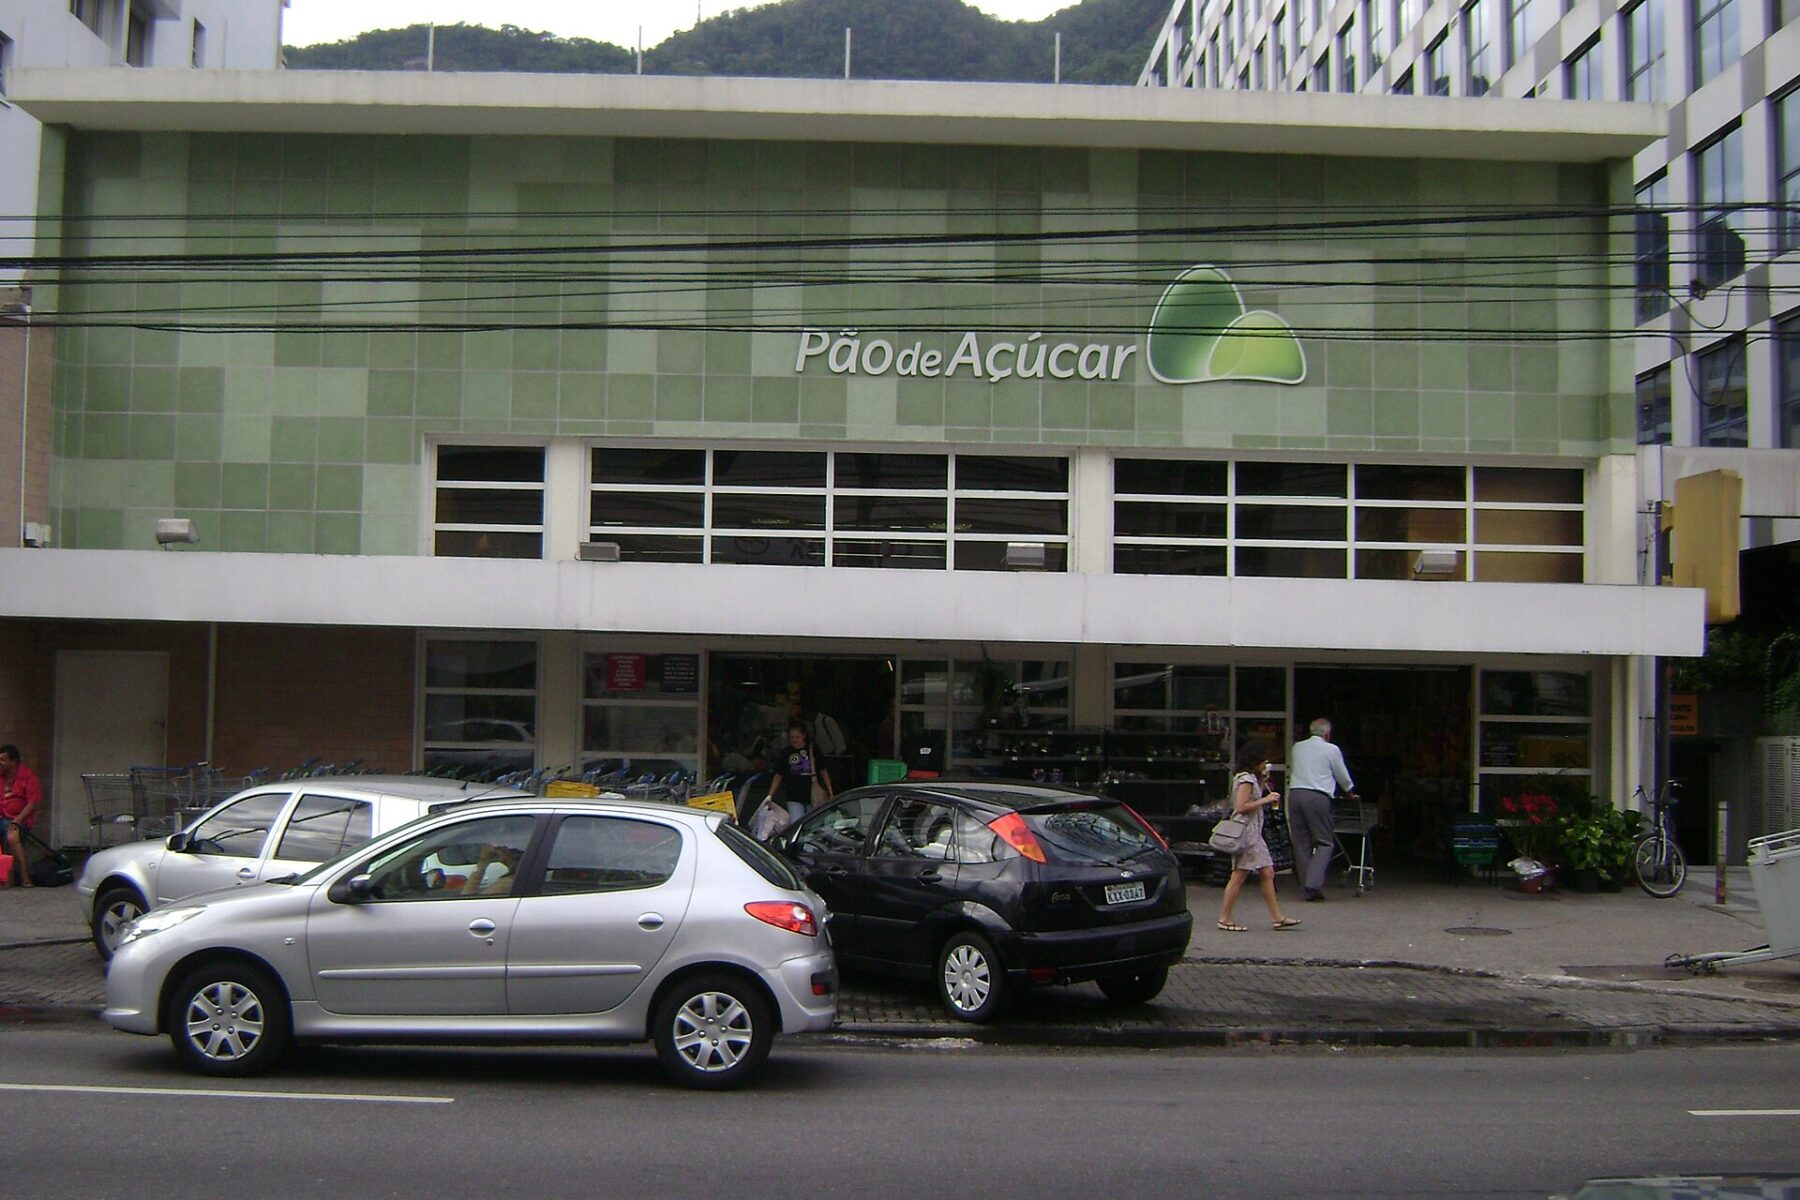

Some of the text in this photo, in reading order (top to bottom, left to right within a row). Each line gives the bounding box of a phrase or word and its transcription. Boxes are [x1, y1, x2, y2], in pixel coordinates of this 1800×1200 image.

[795, 327, 1136, 383] Pão de Açúcar
